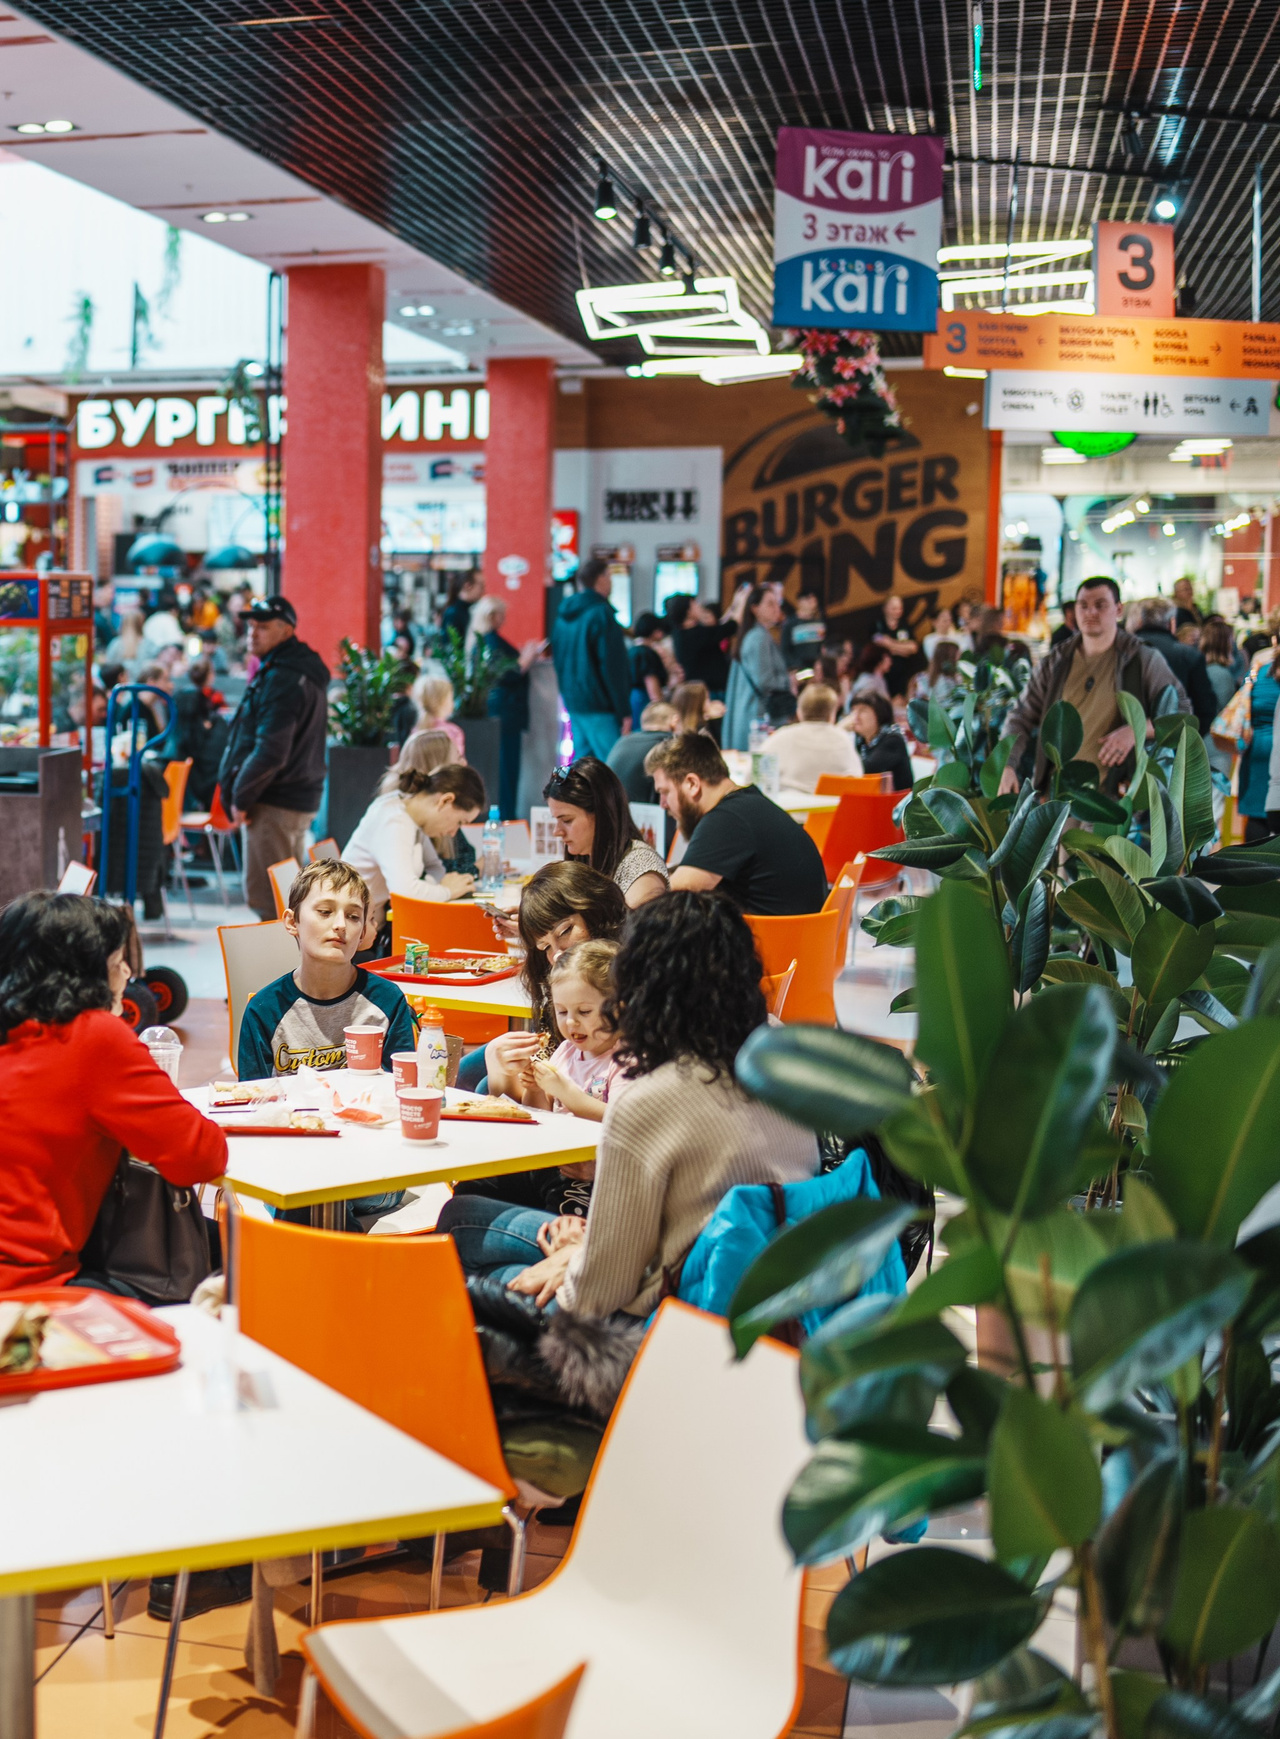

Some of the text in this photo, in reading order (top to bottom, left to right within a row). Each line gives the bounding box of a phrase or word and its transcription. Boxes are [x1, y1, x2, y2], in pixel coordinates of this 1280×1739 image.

[803, 145, 915, 203] kari
[802, 213, 889, 244] 3 этаж
[801, 260, 909, 315] kari
[1118, 234, 1155, 290] 3
[946, 323, 967, 353] 3
[380, 388, 490, 442] ИН
[724, 455, 960, 558] BURGER
[274, 1043, 346, 1072] Custom
